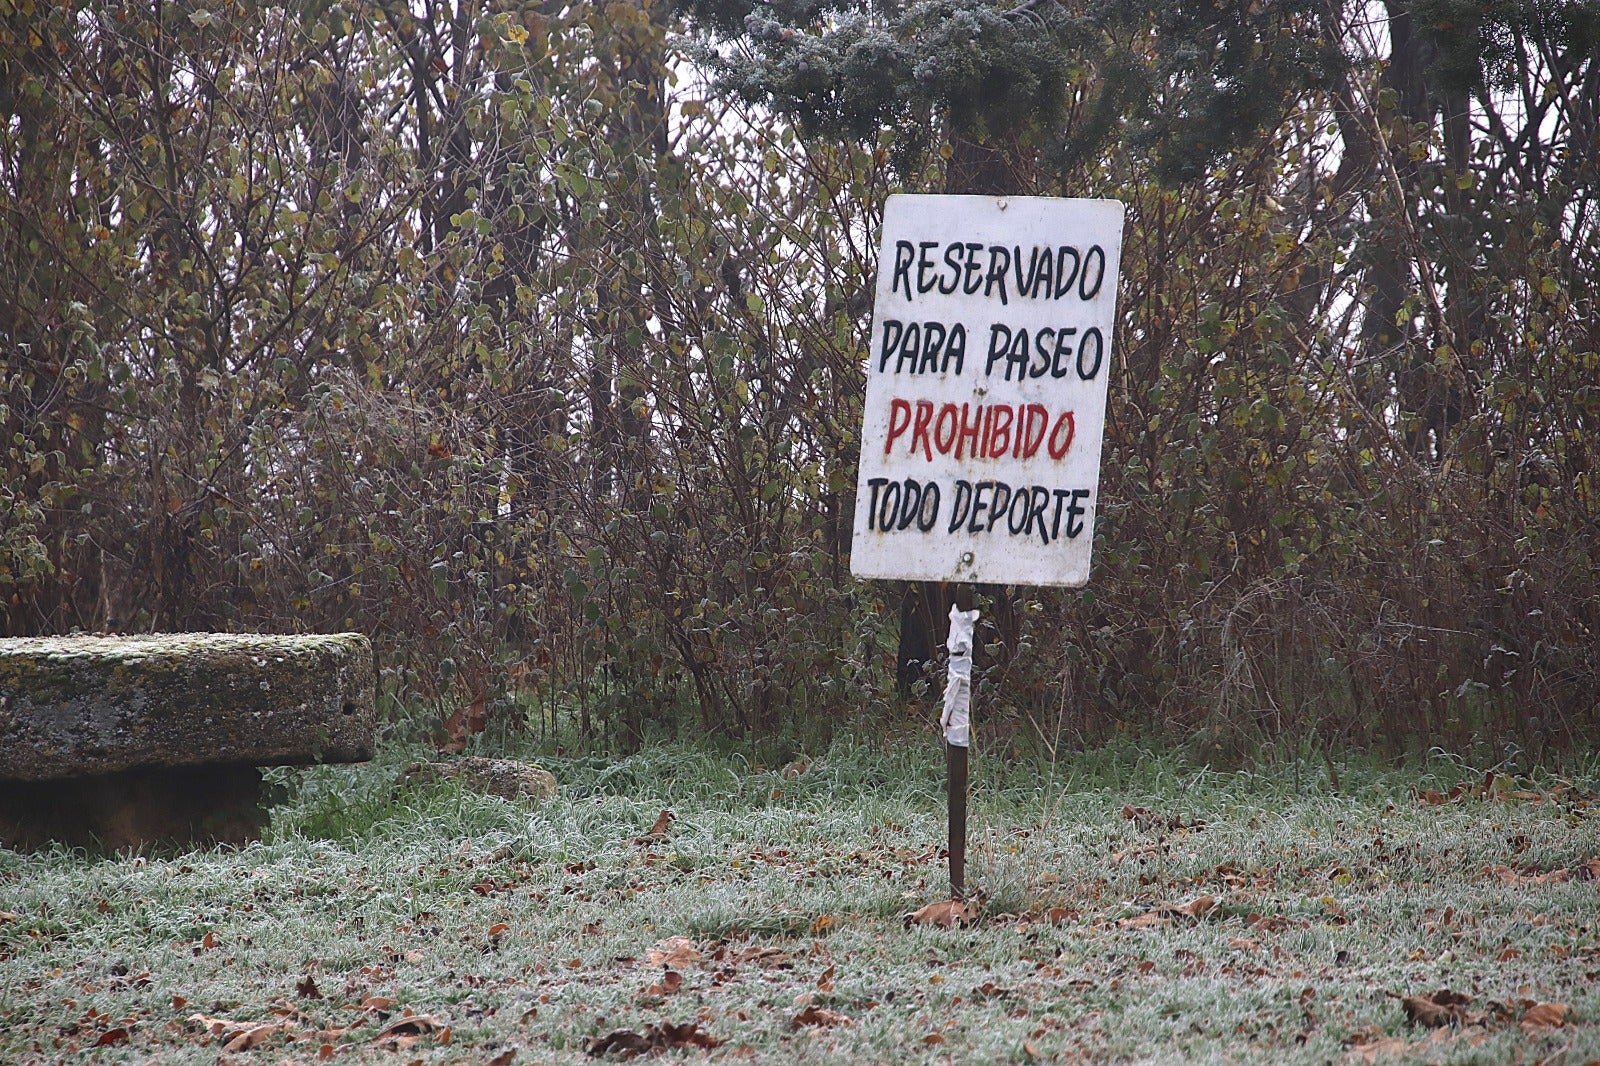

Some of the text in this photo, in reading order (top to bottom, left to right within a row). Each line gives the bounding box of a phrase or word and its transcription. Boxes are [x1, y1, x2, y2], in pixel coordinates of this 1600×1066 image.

[893, 240, 1105, 305] RESERVADO
[878, 320, 1104, 381] PARA PASEO
[885, 398, 1075, 462] PROHIBIDO
[867, 478, 1090, 545] TODO DEPORTE
